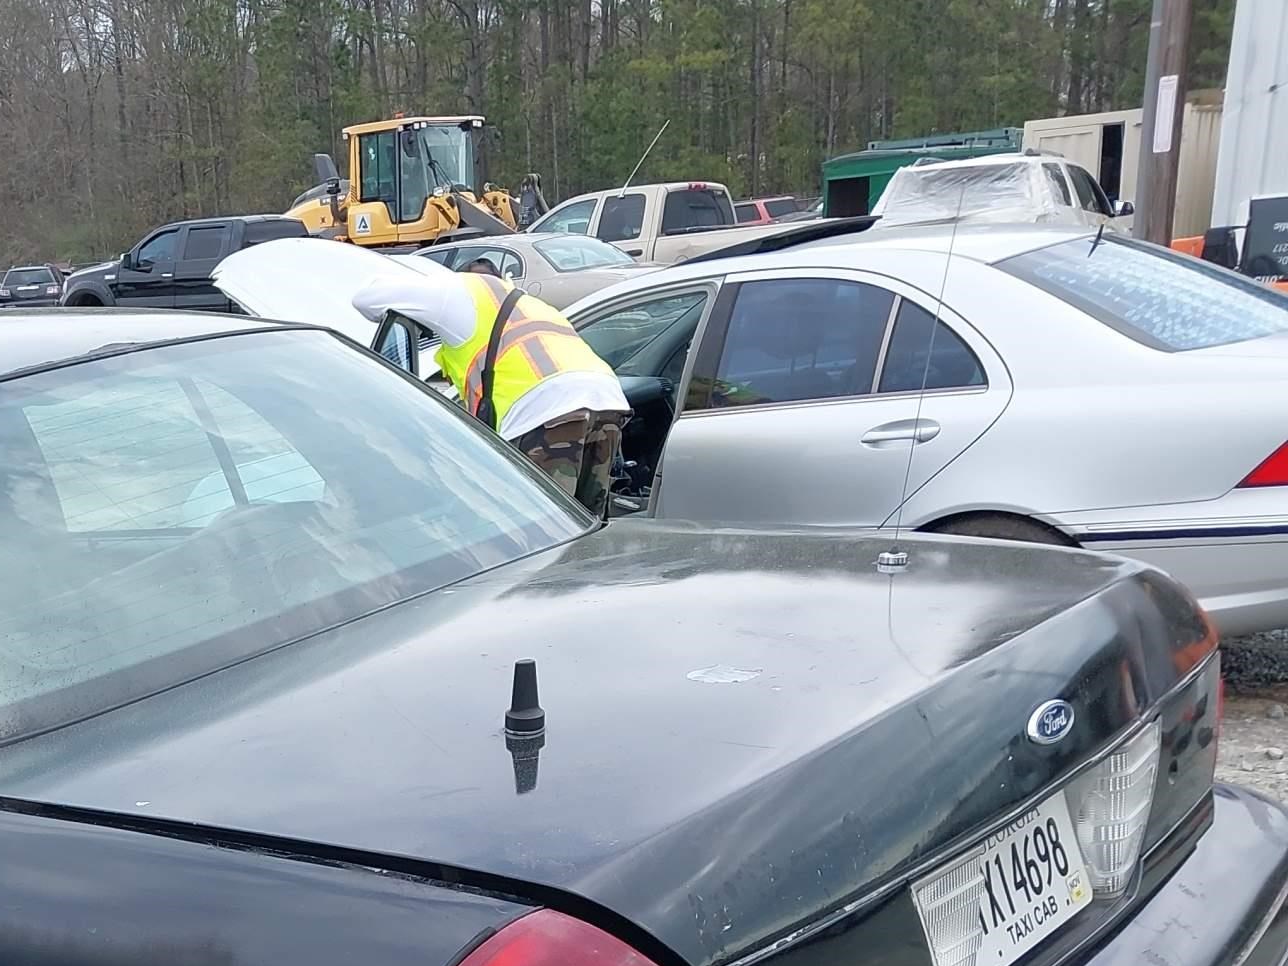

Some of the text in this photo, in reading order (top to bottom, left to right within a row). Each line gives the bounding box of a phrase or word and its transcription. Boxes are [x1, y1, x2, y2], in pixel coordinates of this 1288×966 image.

[1043, 708, 1067, 735] Ford
[978, 817, 1069, 936] X14698
[1006, 895, 1058, 945] TAXI CAB
